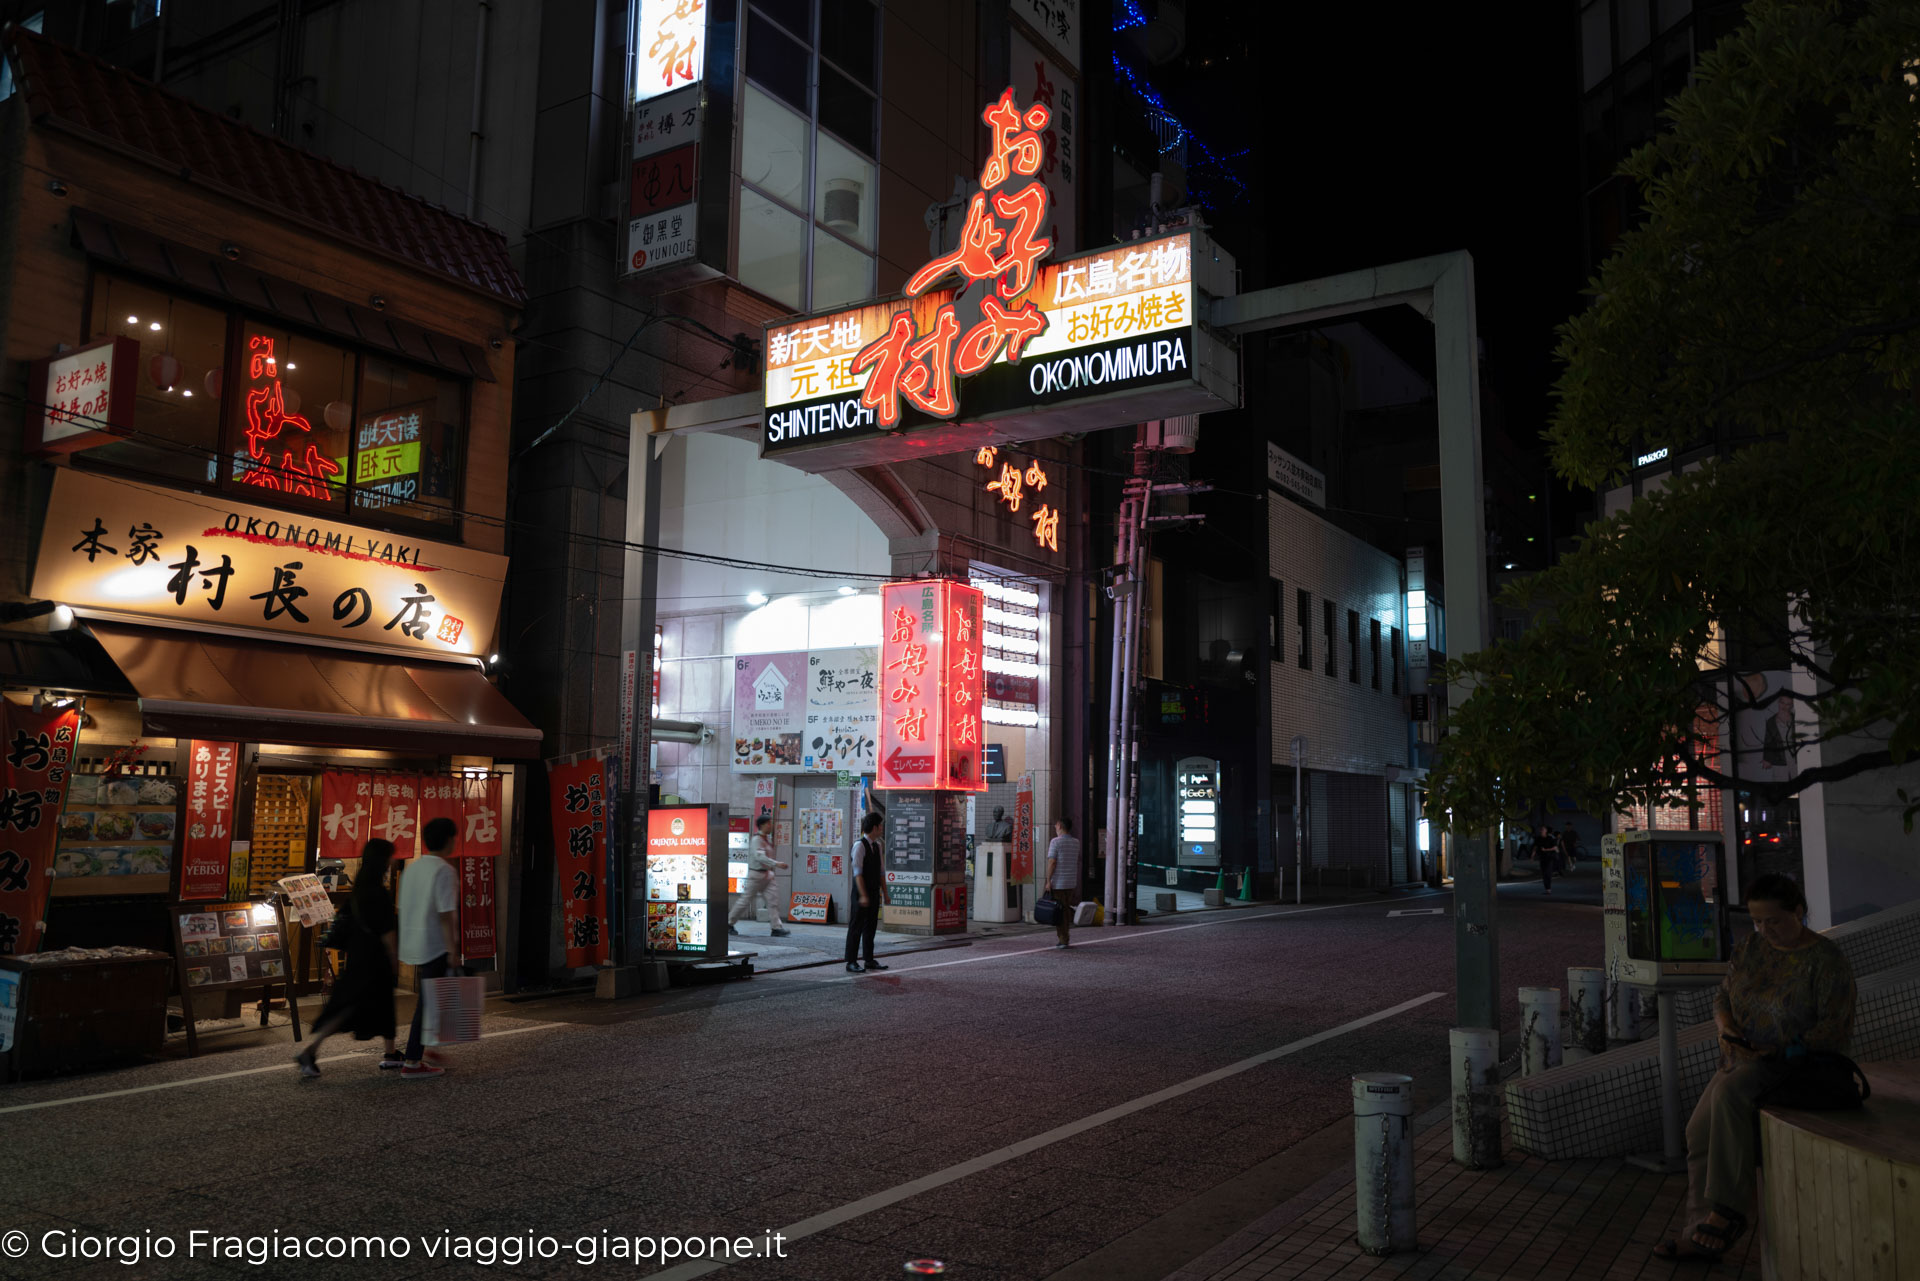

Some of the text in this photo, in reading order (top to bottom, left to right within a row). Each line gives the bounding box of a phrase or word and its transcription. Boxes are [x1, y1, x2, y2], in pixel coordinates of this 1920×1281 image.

[639, 109, 650, 120] 1F
[1060, 87, 1073, 184] 広島名物
[632, 223, 641, 233] 1F
[650, 239, 692, 262] YUNIQUE
[1054, 241, 1188, 305] 広島名物
[1067, 289, 1187, 345] お好み焼き
[769, 317, 862, 366] 新天地
[56, 361, 107, 394] お好み焼
[790, 357, 859, 400] 元祖
[1030, 337, 1187, 396] OKONOMIMURA
[49, 390, 108, 426] 村長の店
[72, 517, 162, 566] 本家
[225, 513, 421, 567] OKONOMI YAKI
[166, 545, 435, 642] 村長の店
[737, 660, 749, 670] 6F
[810, 656, 820, 666] 6F
[886, 605, 928, 742] お好み村
[953, 607, 978, 745] お好み村
[816, 669, 874, 693] 鮮や一夜
[750, 718, 772, 726] UMEKO
[808, 715, 819, 724] 5F
[812, 733, 875, 760] ひなた
[44, 727, 73, 805] 広島名物
[893, 758, 932, 770] エレベーター
[321, 802, 498, 844] 村長店
[650, 837, 706, 846] ORIENTAL LOUNGE
[185, 865, 225, 877] YEBISU
[564, 783, 599, 948] お好み焼
[794, 895, 827, 904] お好み村
[465, 930, 493, 939] YEBISU
